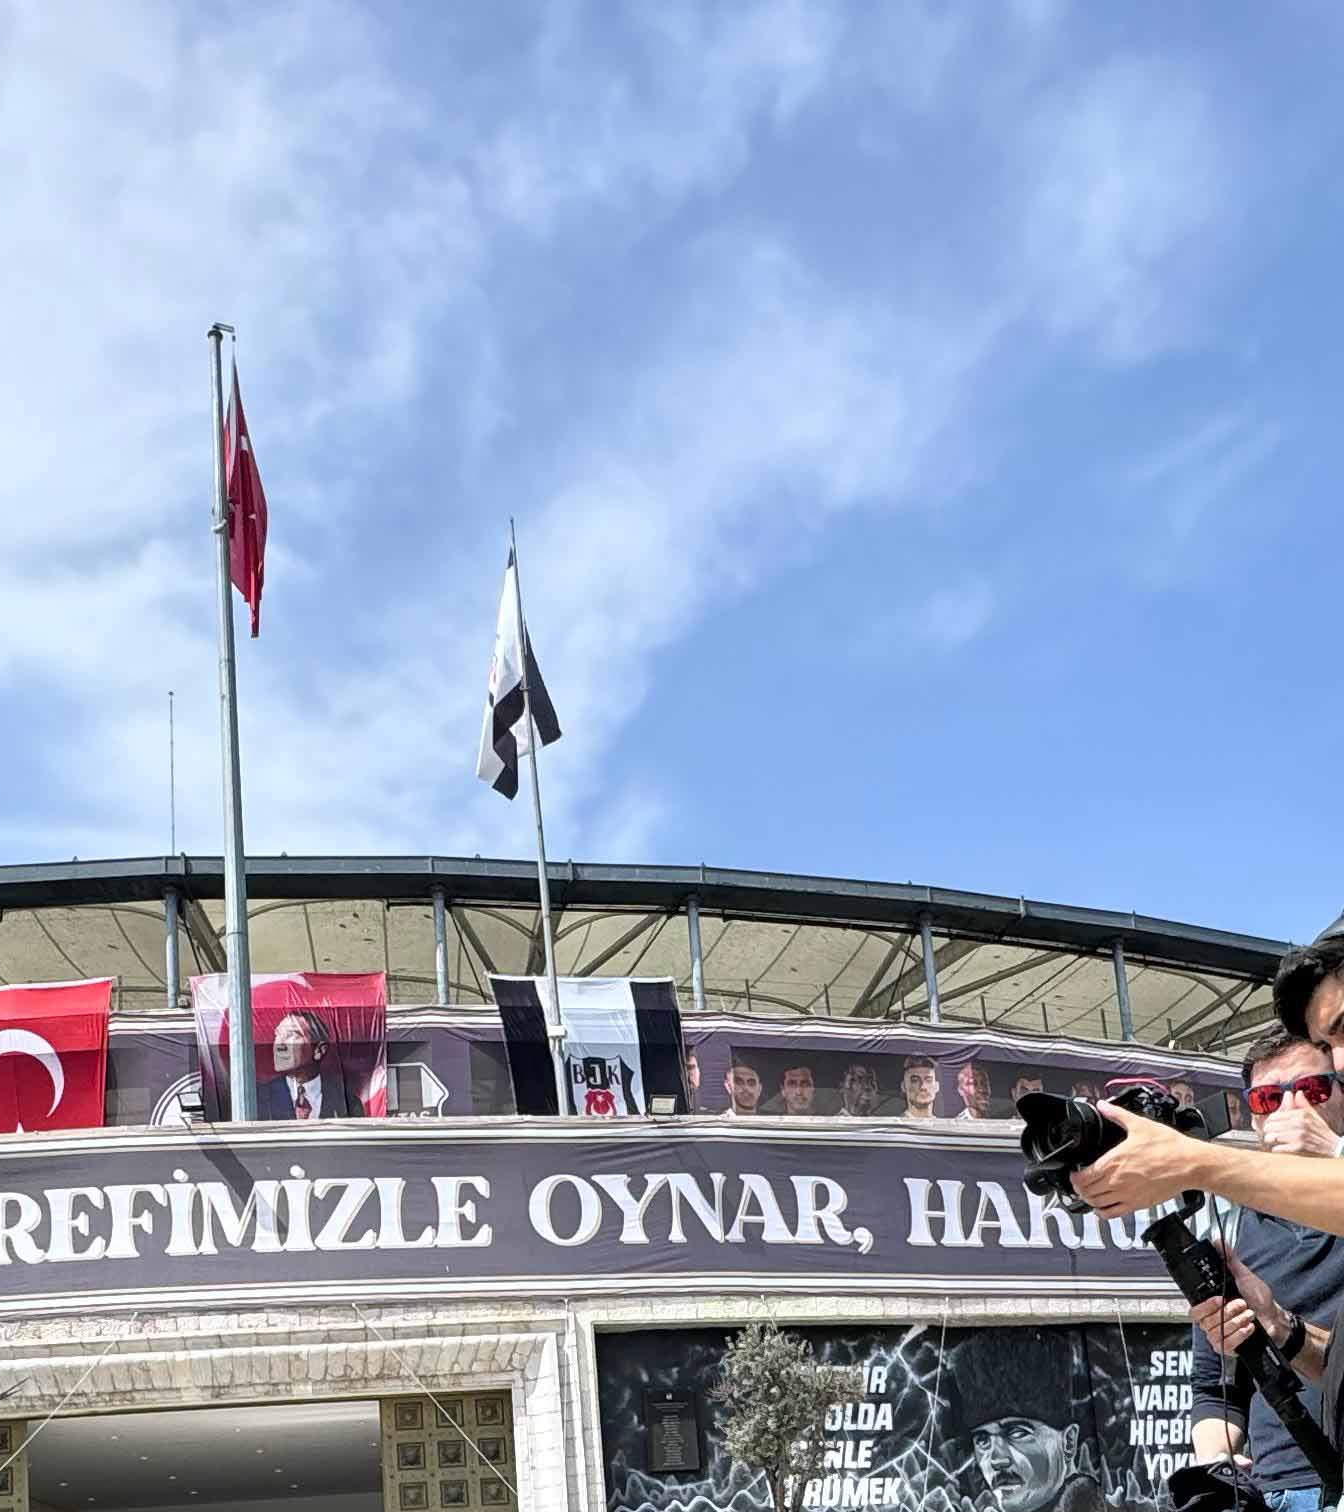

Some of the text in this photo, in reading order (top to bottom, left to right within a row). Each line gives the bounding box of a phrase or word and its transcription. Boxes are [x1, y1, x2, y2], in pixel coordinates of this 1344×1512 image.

[573, 1063, 621, 1086] BJK
[528, 1173, 874, 1255] OYNAR,
[1149, 1350, 1194, 1377] SEN
[824, 1402, 894, 1431] OLDA
[768, 1475, 902, 1508] RÜMEK
